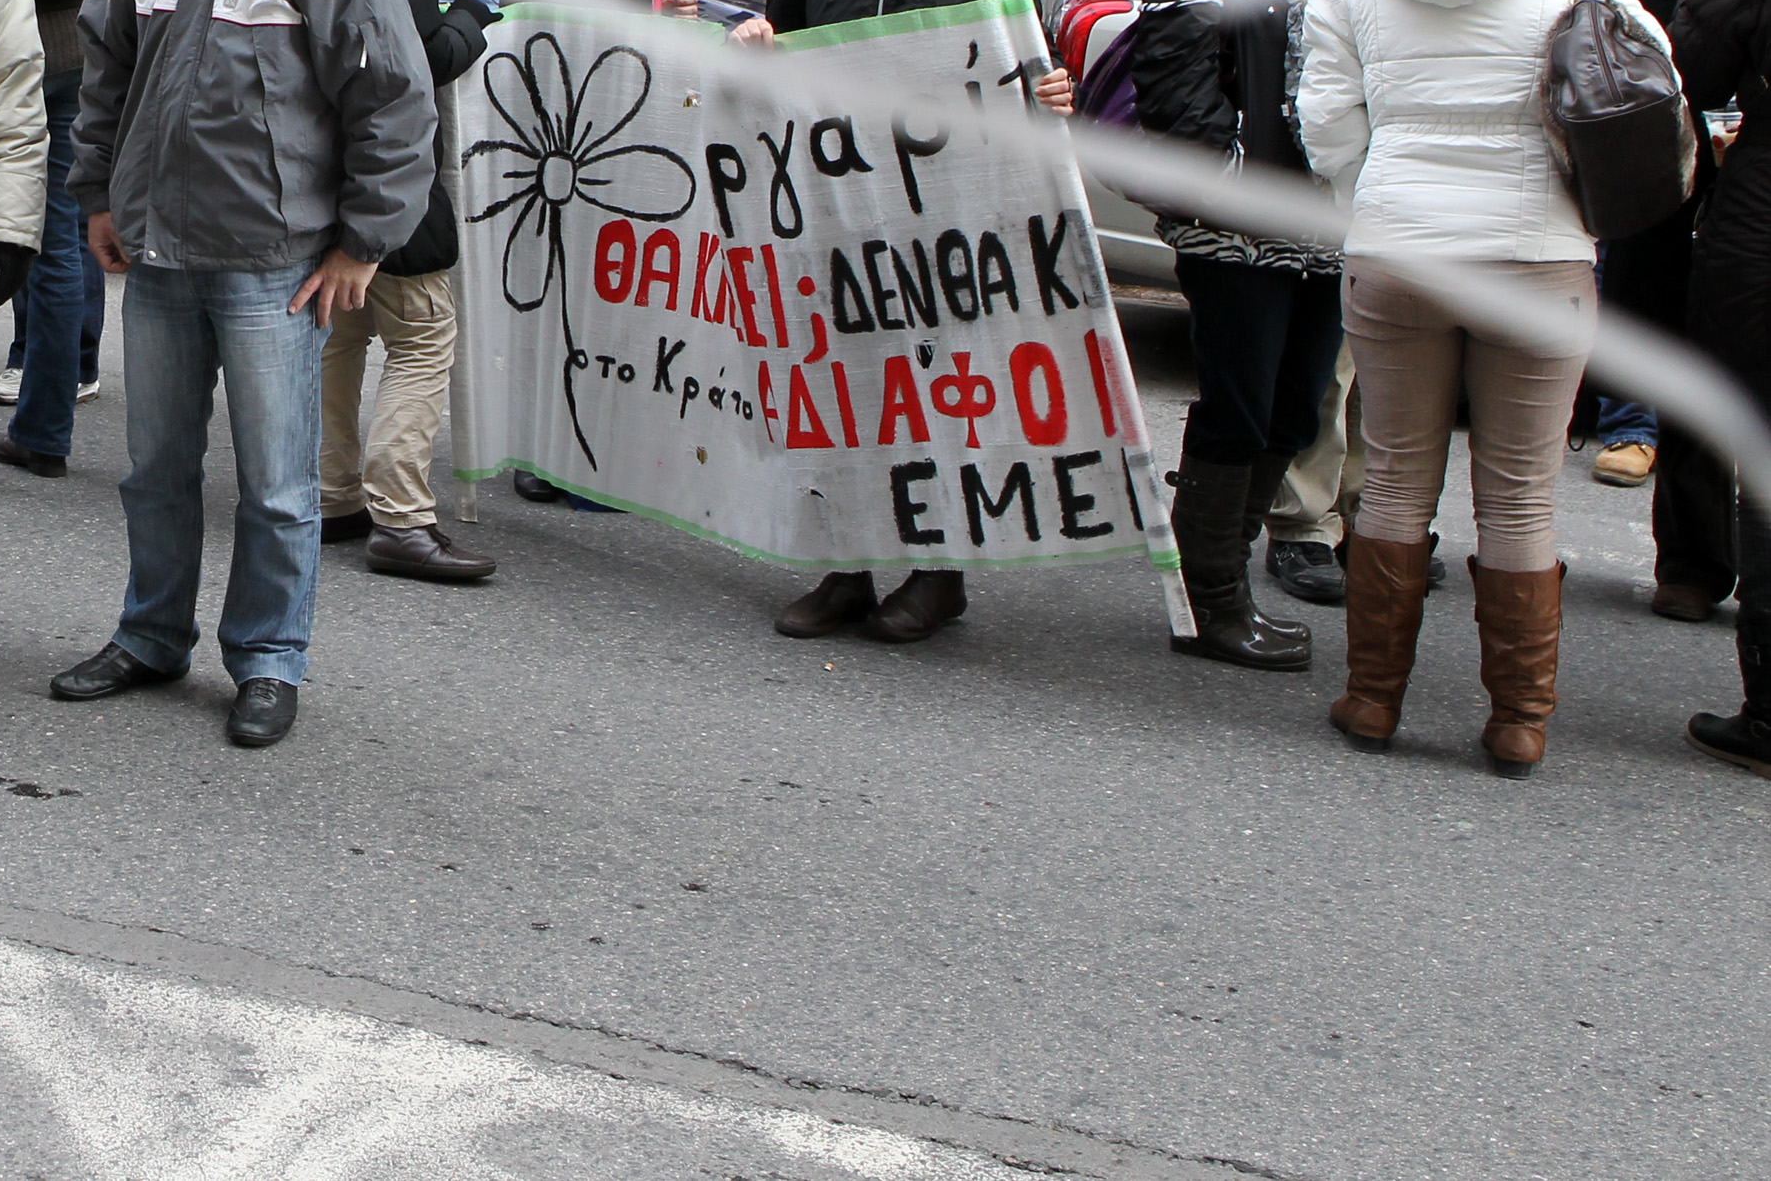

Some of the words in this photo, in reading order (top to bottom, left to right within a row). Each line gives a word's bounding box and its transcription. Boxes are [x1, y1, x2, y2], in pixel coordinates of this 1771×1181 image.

[594, 219, 681, 311] ΘΑ
[830, 238, 940, 334] ΔΕΝ
[935, 228, 1020, 321] ΘΑ
